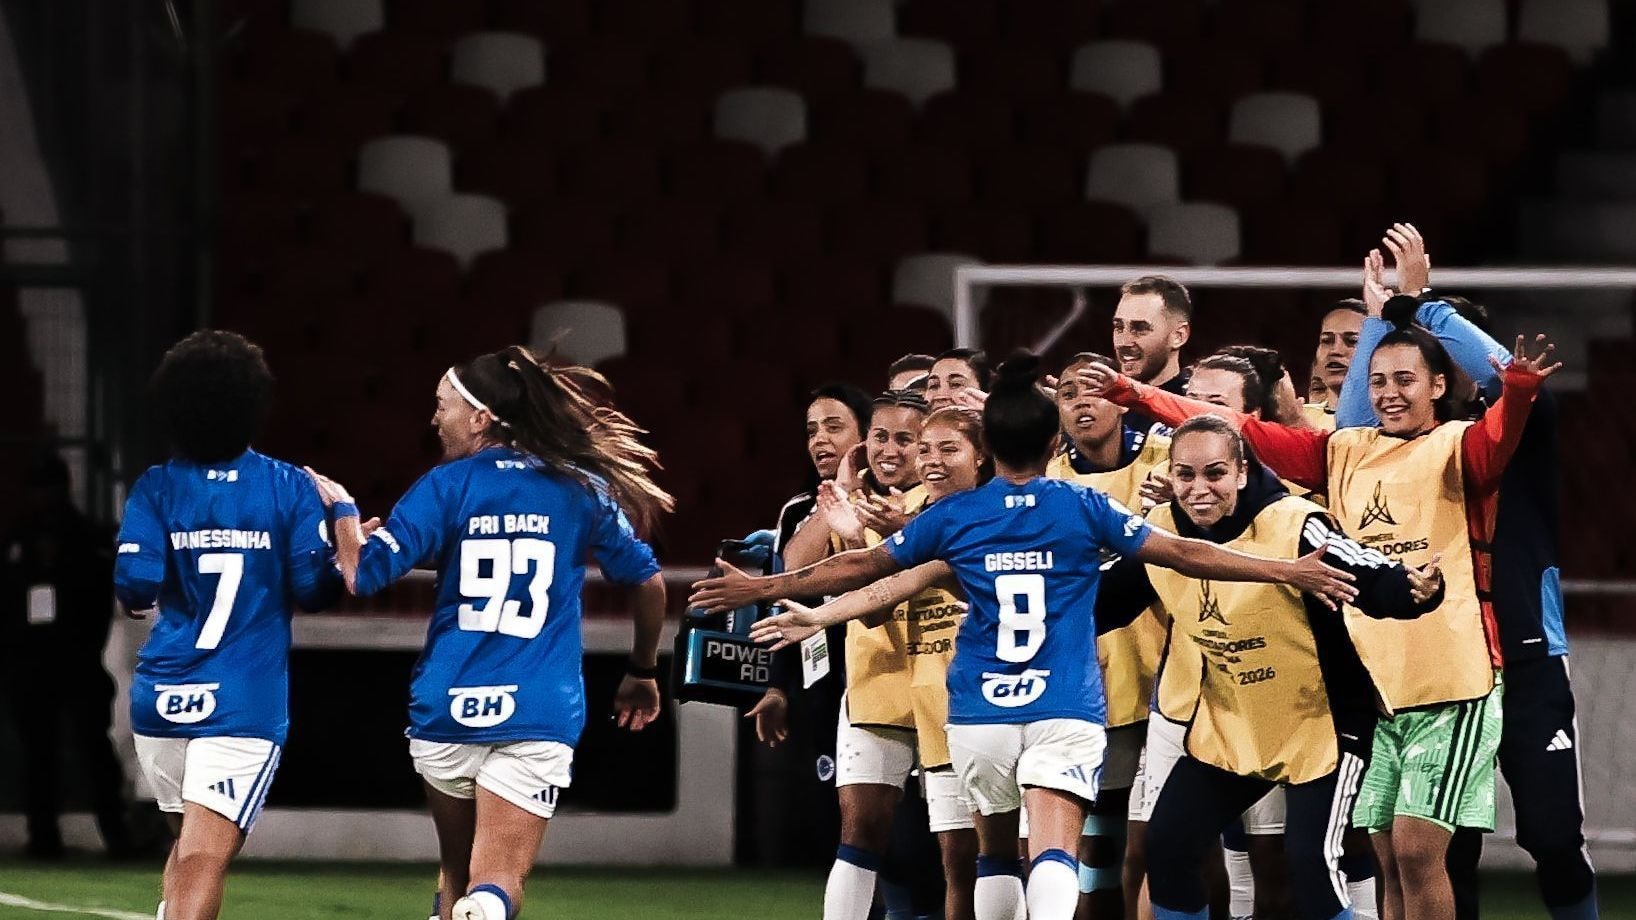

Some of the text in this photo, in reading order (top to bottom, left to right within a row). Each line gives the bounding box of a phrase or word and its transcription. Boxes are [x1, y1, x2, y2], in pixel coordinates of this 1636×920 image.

[469, 514, 549, 535] PRI BACK
[170, 529, 272, 550] VANESSINHA
[984, 550, 1053, 572] GISSELI
[458, 538, 556, 639] 93
[195, 552, 244, 650] 7
[995, 574, 1046, 663] 8
[706, 641, 776, 666] POWE
[1238, 666, 1277, 686] 2026
[165, 693, 206, 715] BH
[461, 695, 503, 719] BH
